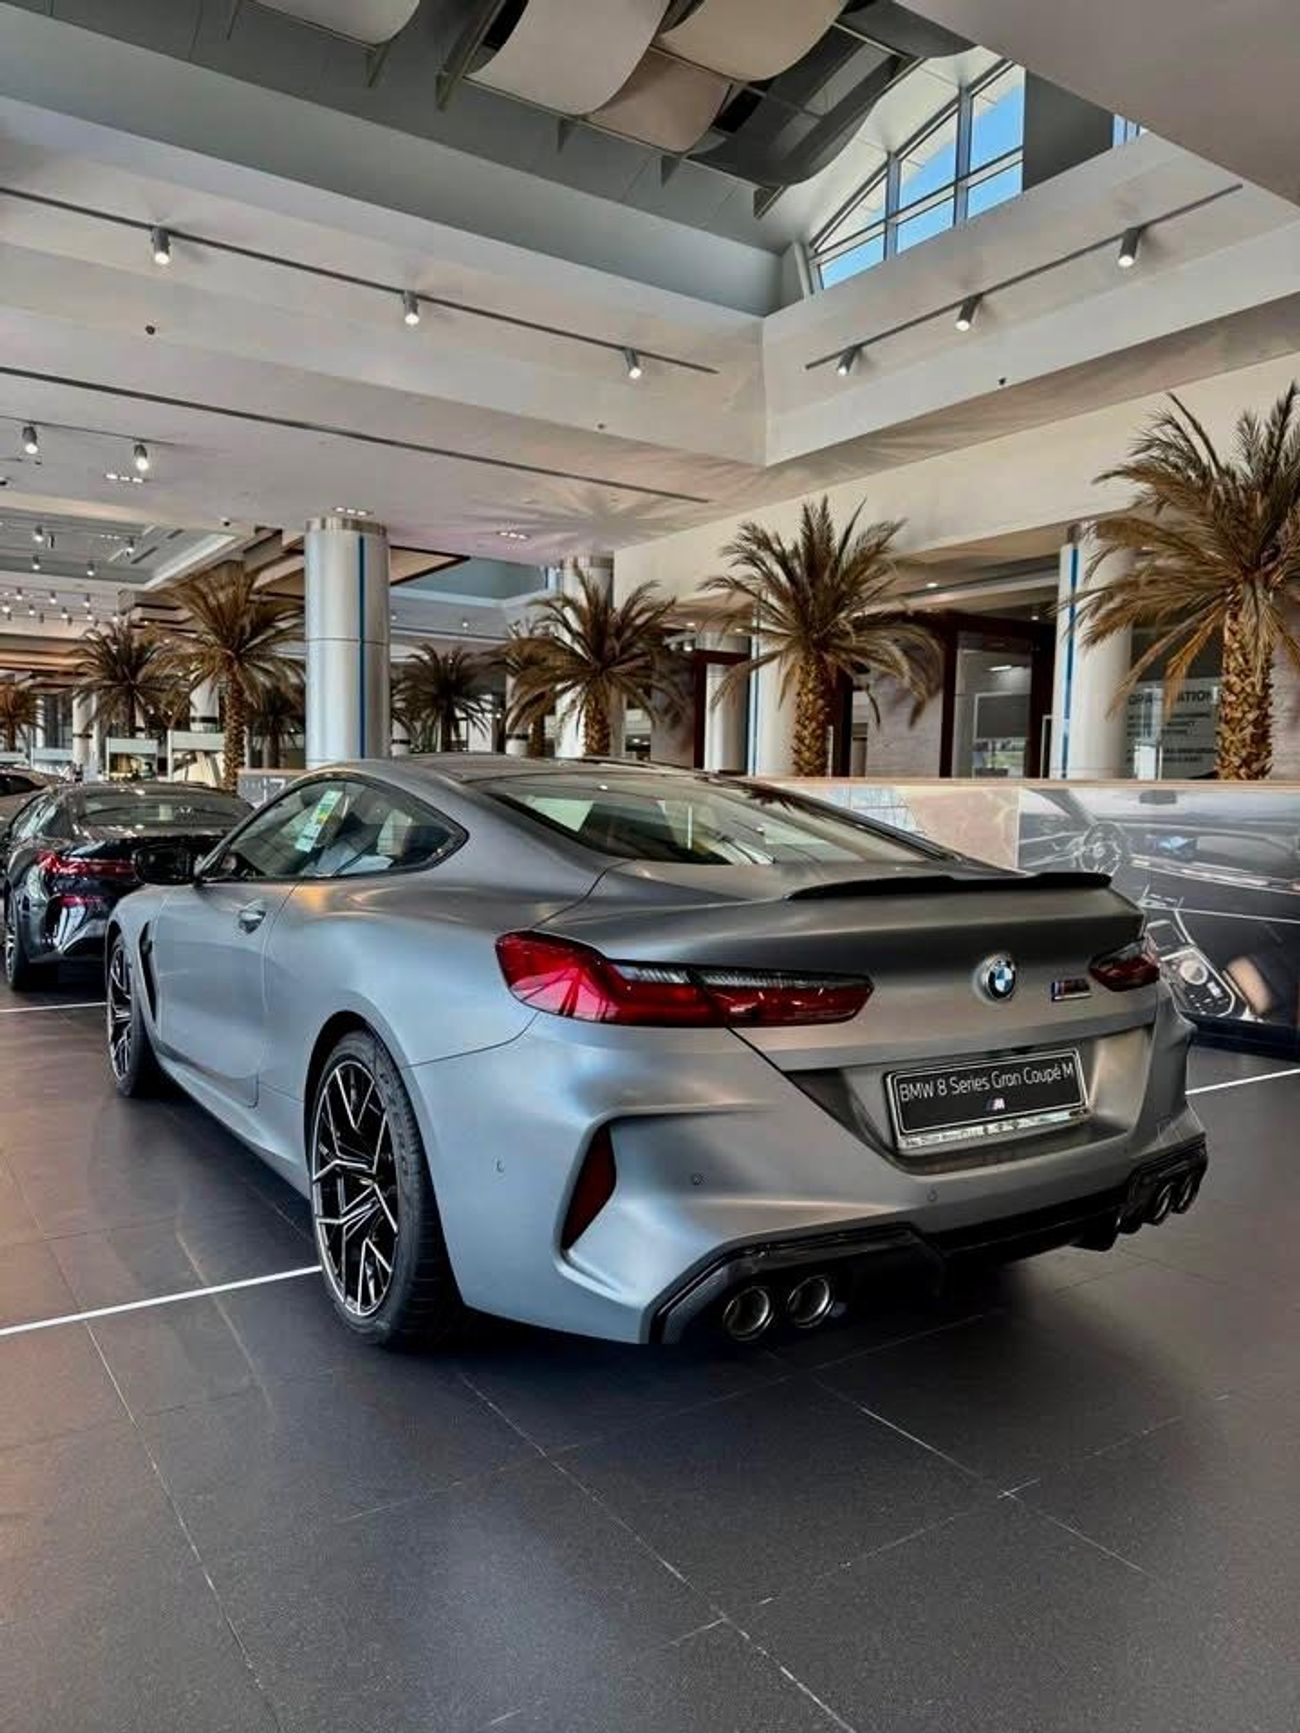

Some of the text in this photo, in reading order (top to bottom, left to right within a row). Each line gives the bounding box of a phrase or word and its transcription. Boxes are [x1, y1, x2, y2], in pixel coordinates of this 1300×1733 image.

[899, 1062, 1075, 1102] BMW 8 Series Gran Coupé M
